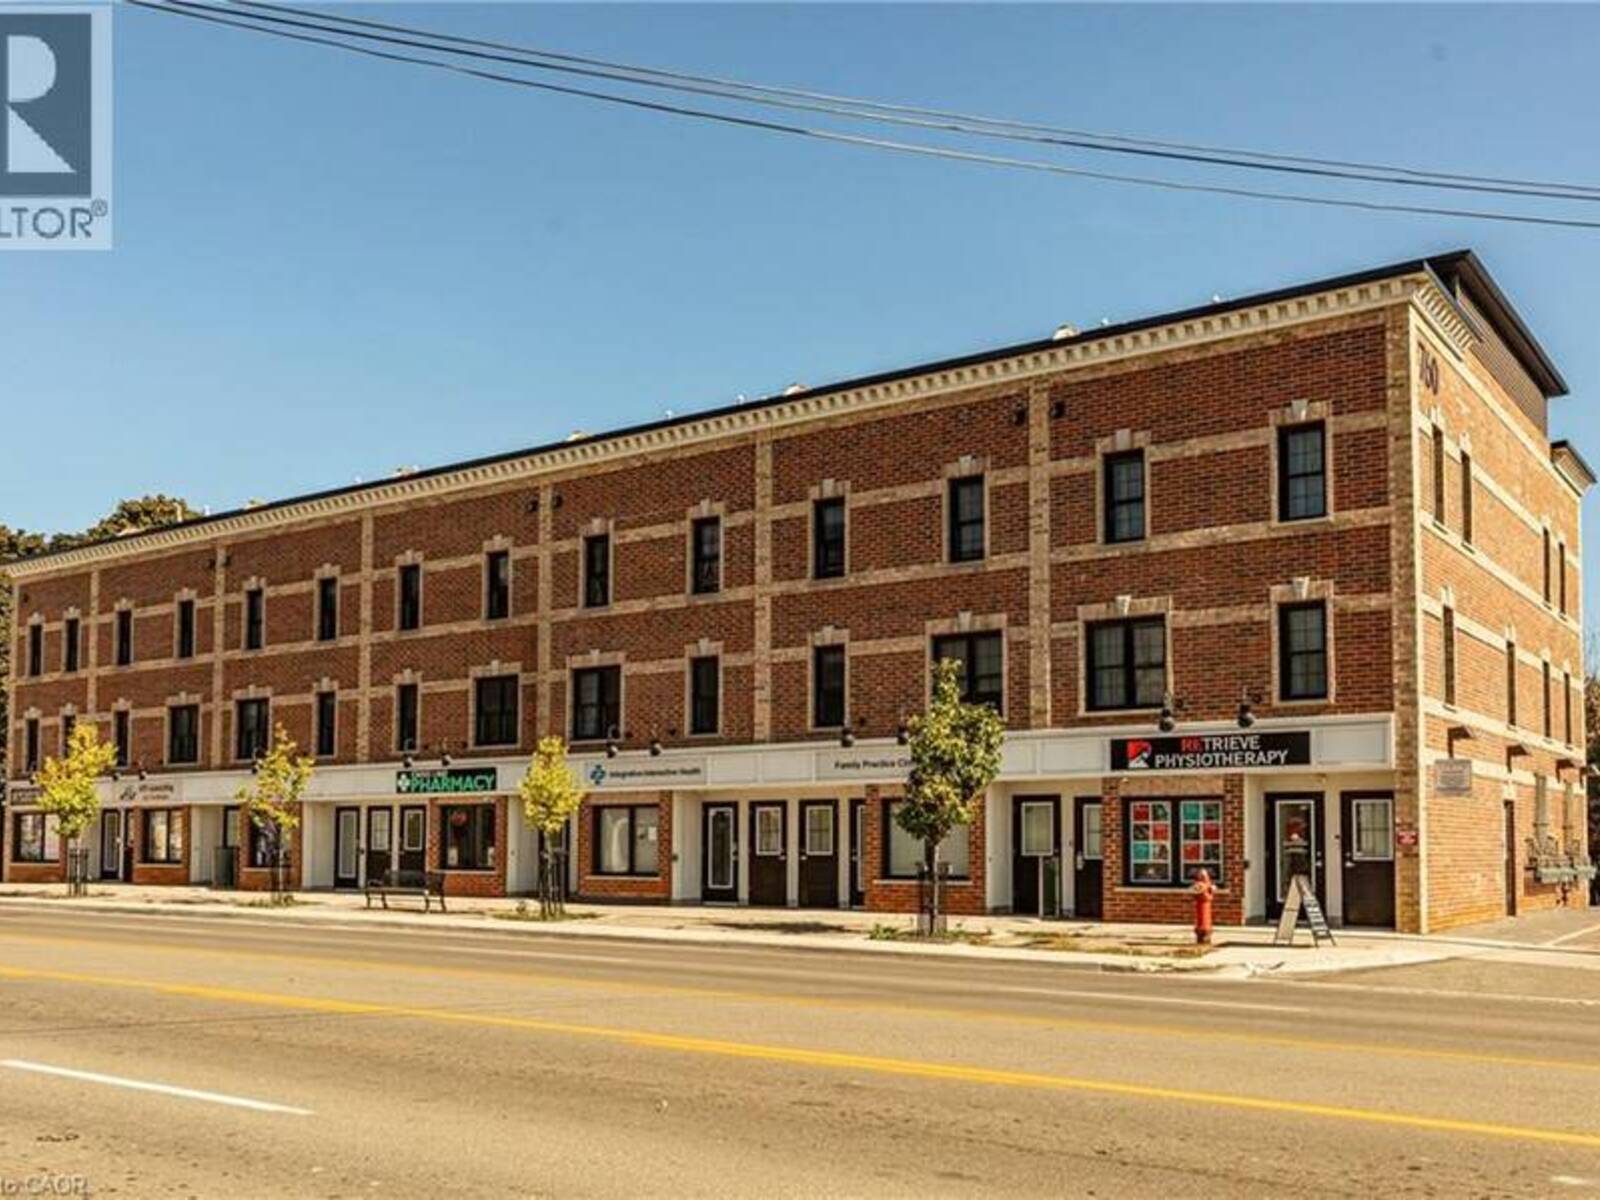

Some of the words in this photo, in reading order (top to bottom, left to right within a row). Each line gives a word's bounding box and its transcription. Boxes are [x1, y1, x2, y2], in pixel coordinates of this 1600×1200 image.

[1181, 735, 1261, 752] RETRIEVE
[1154, 749, 1288, 768] PHYSIOTHERAPY
[411, 774, 495, 793] PHARMACY
